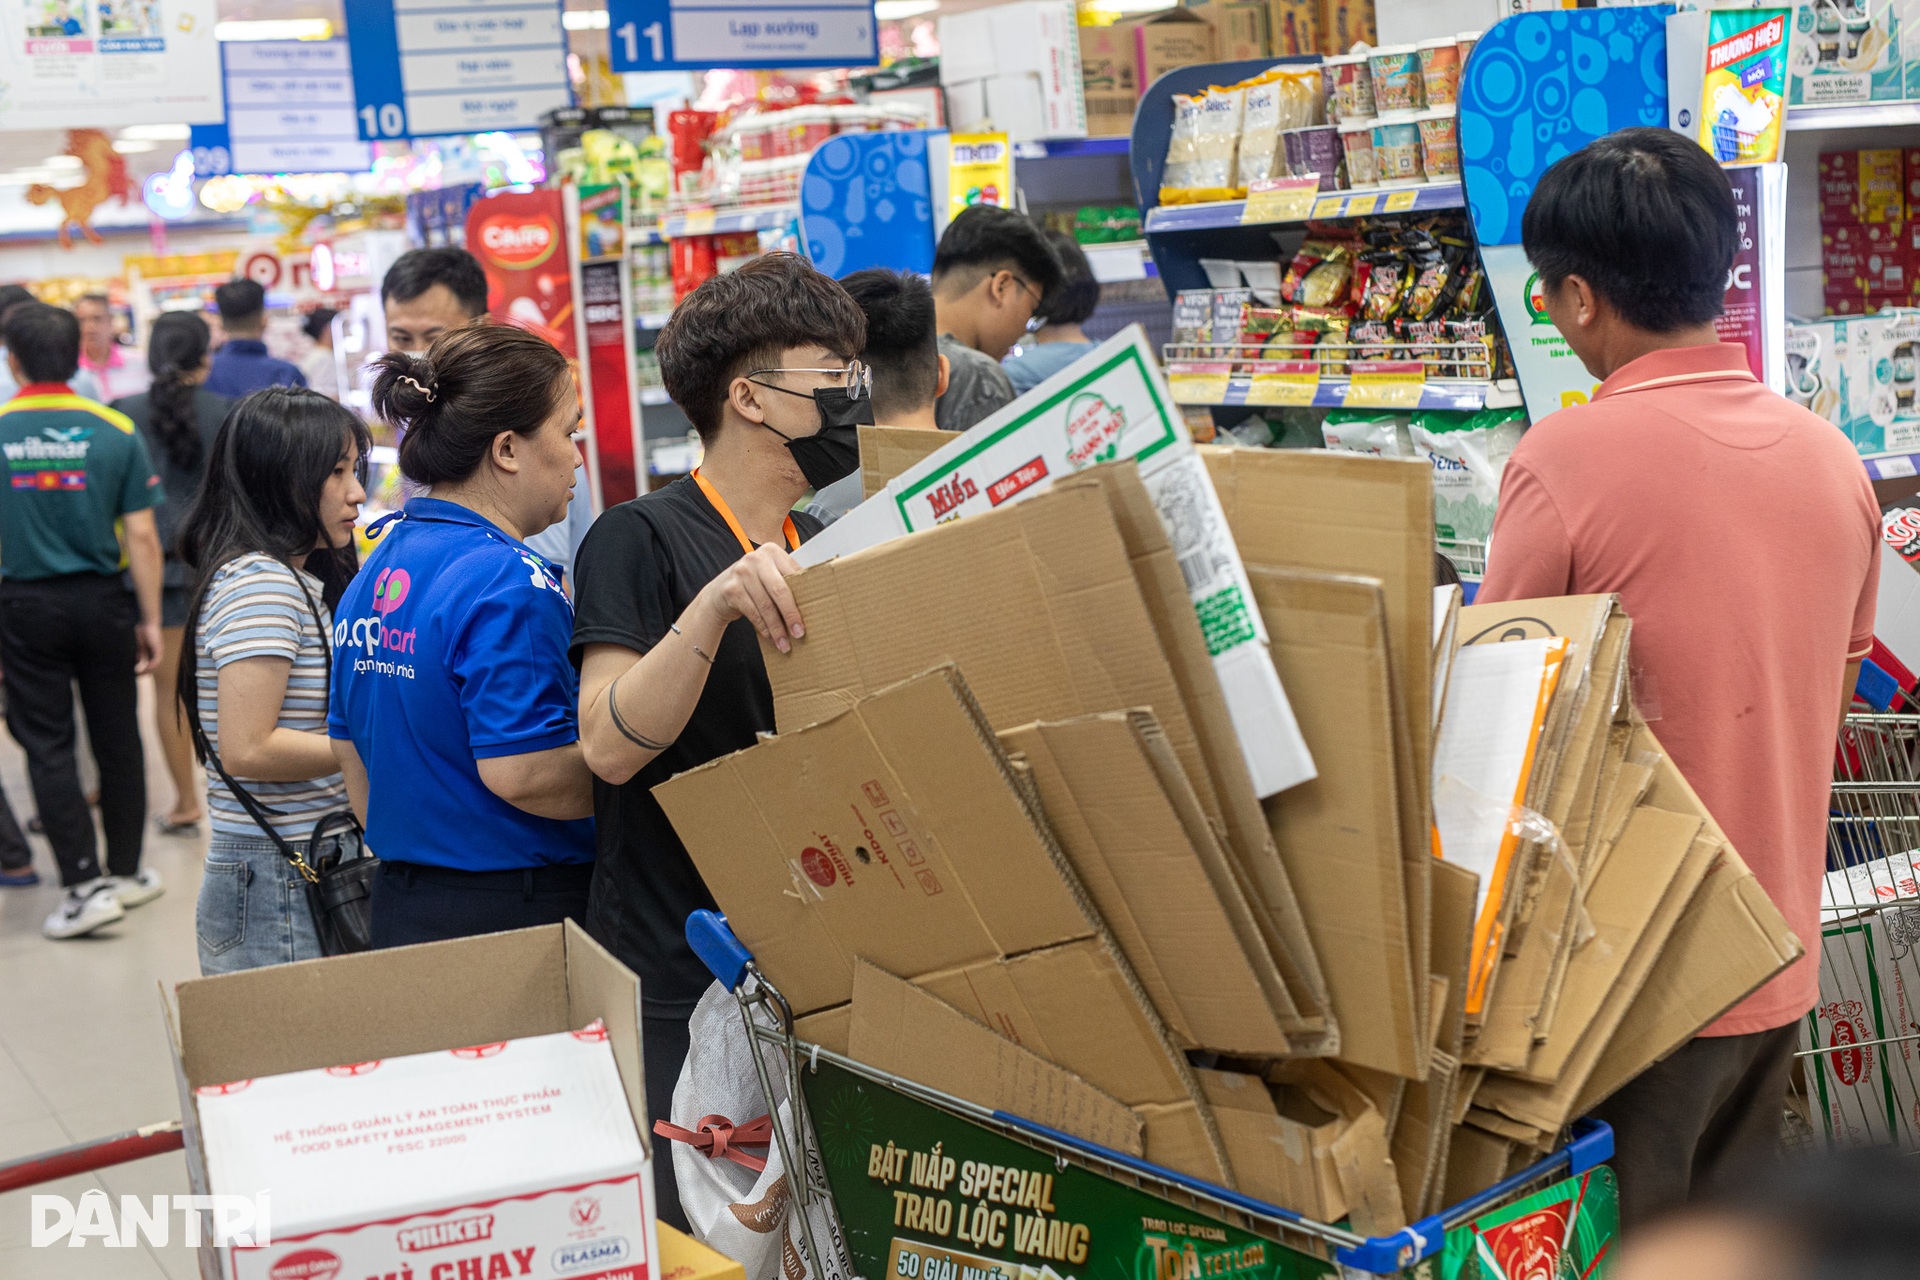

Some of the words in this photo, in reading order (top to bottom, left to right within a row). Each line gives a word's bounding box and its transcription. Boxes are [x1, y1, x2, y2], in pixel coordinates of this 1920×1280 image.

[615, 21, 665, 63] 11
[359, 103, 405, 138] 10
[2, 436, 90, 460] wilmar
[926, 472, 979, 520] Miến
[376, 660, 395, 678] mọi
[863, 828, 889, 865] KIDO
[1854, 1017, 1873, 1039] Cook
[291, 1140, 332, 1155] FOOD
[335, 1130, 388, 1148] SAFETY
[393, 1113, 492, 1139] MANAGEMENT
[496, 1103, 553, 1122] SYSTEM
[387, 1139, 425, 1154] FSSC
[868, 1139, 908, 1186] BẬT
[909, 1140, 957, 1192] NẮP
[959, 1159, 1056, 1213] SPECIAL
[397, 1213, 495, 1252] MILIKET
[893, 1190, 953, 1238] TRAO
[956, 1199, 1008, 1250] LỘC
[1013, 1208, 1091, 1266] VÀNG
[561, 1242, 622, 1267] PLASMA
[896, 1250, 920, 1279] 50
